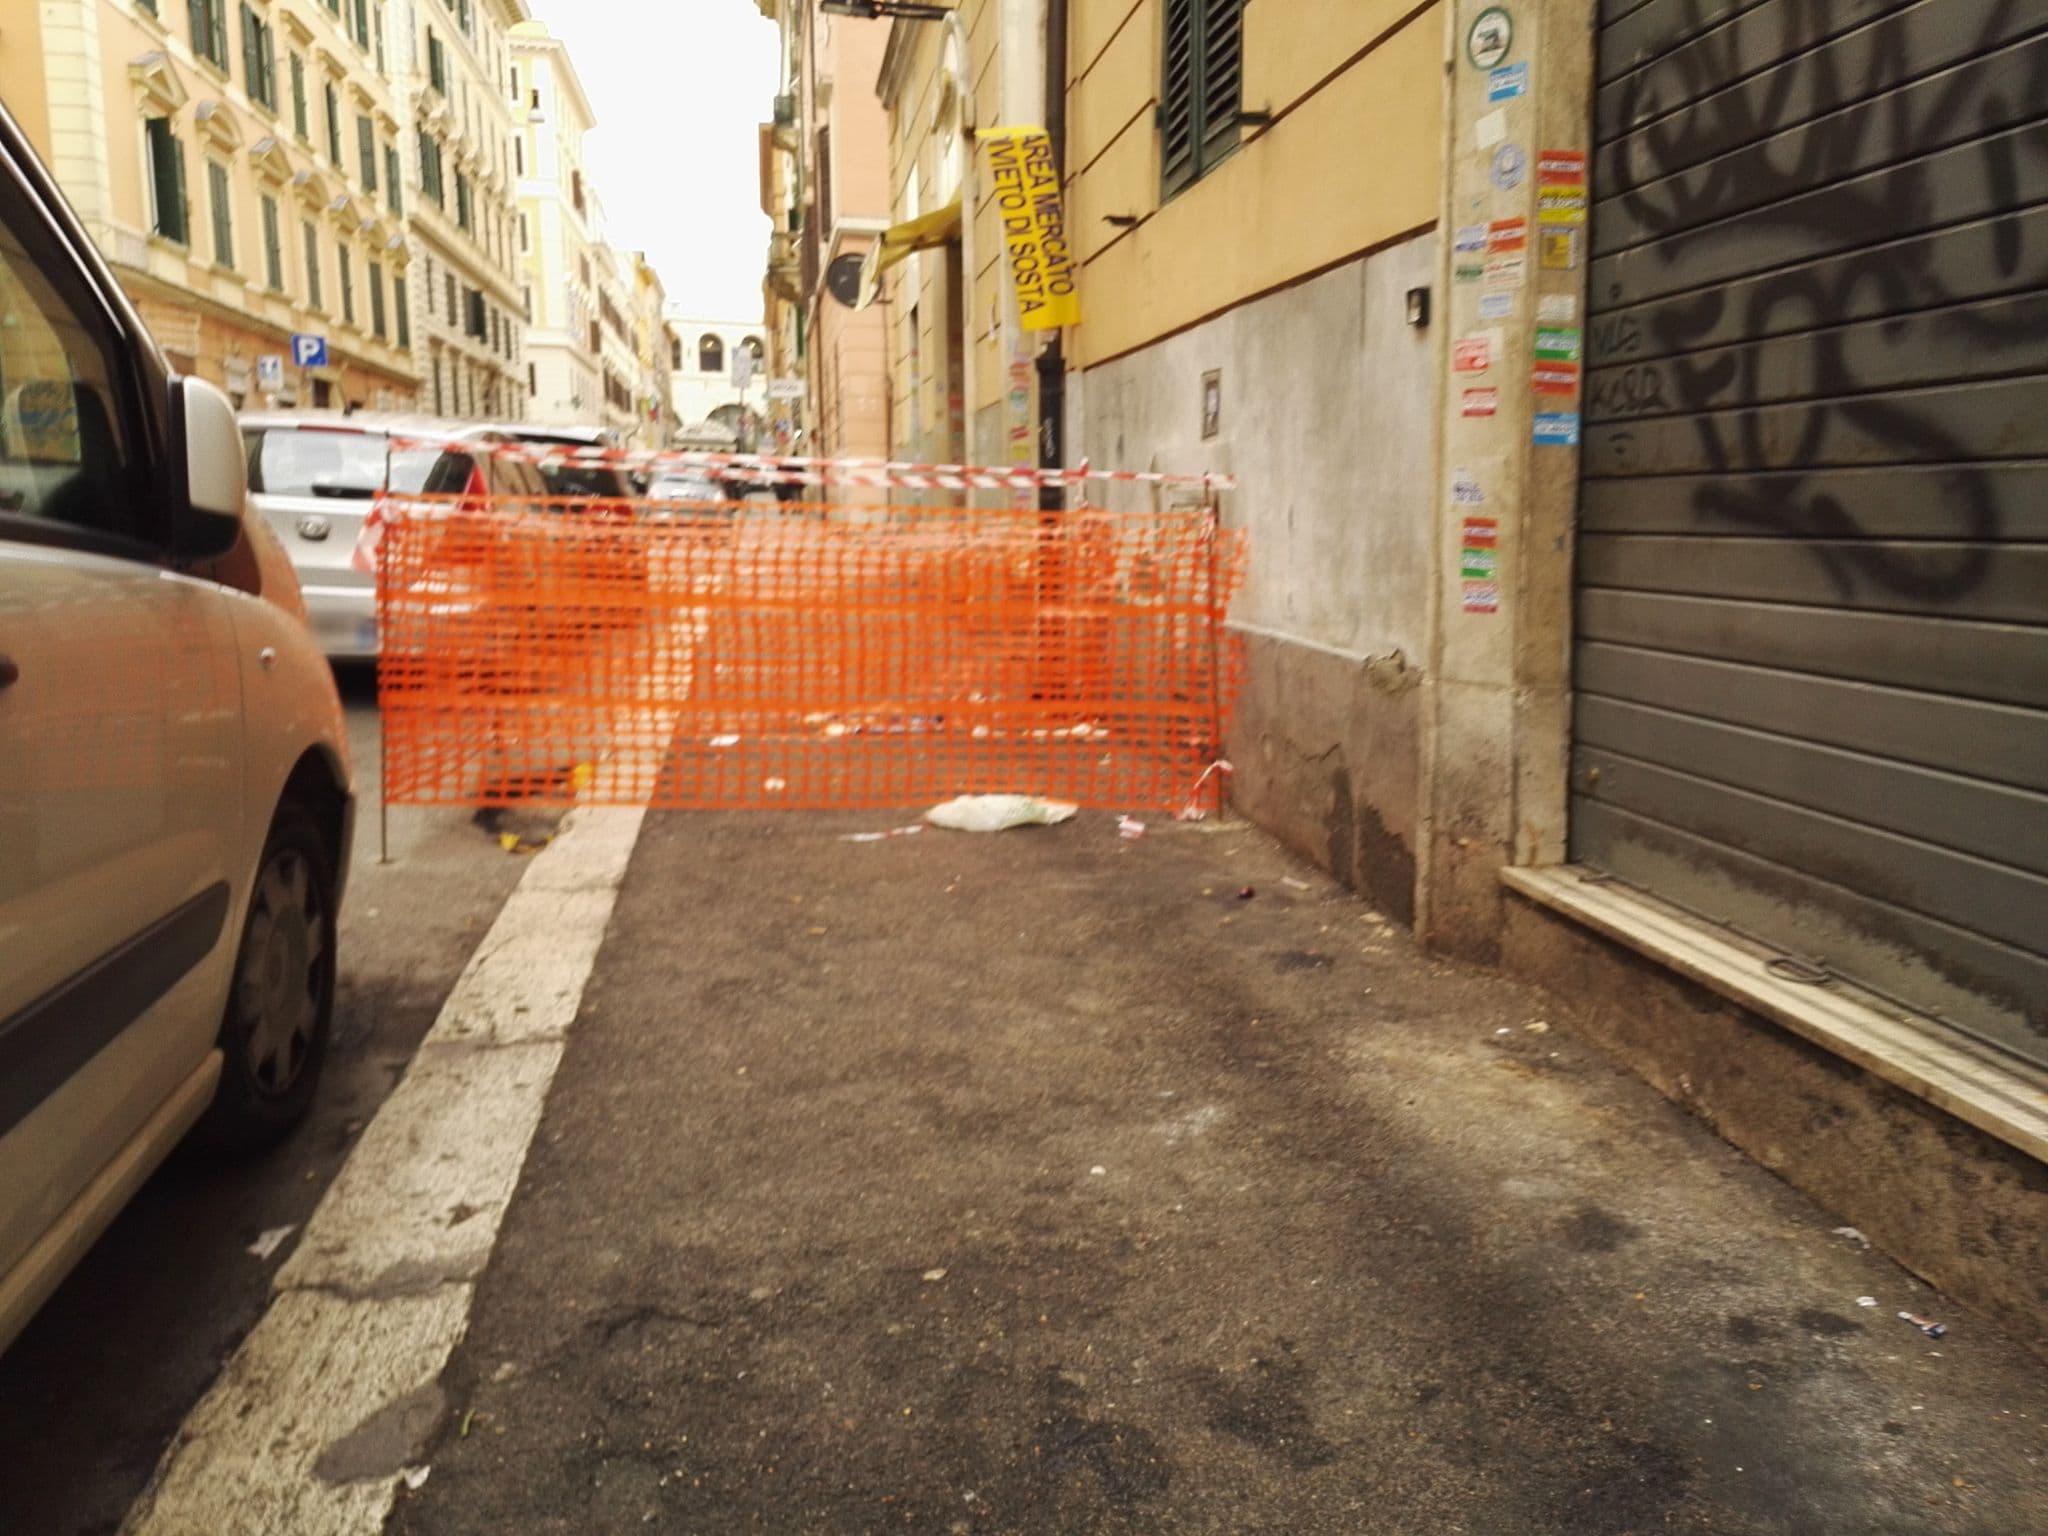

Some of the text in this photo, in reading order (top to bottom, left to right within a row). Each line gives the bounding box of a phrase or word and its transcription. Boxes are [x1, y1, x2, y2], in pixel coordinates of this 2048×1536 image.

[1004, 215, 1031, 238] DI
[1023, 134, 1074, 296] AREA MERCATO
[1009, 242, 1045, 315] SOSTA
[298, 337, 320, 364] P
